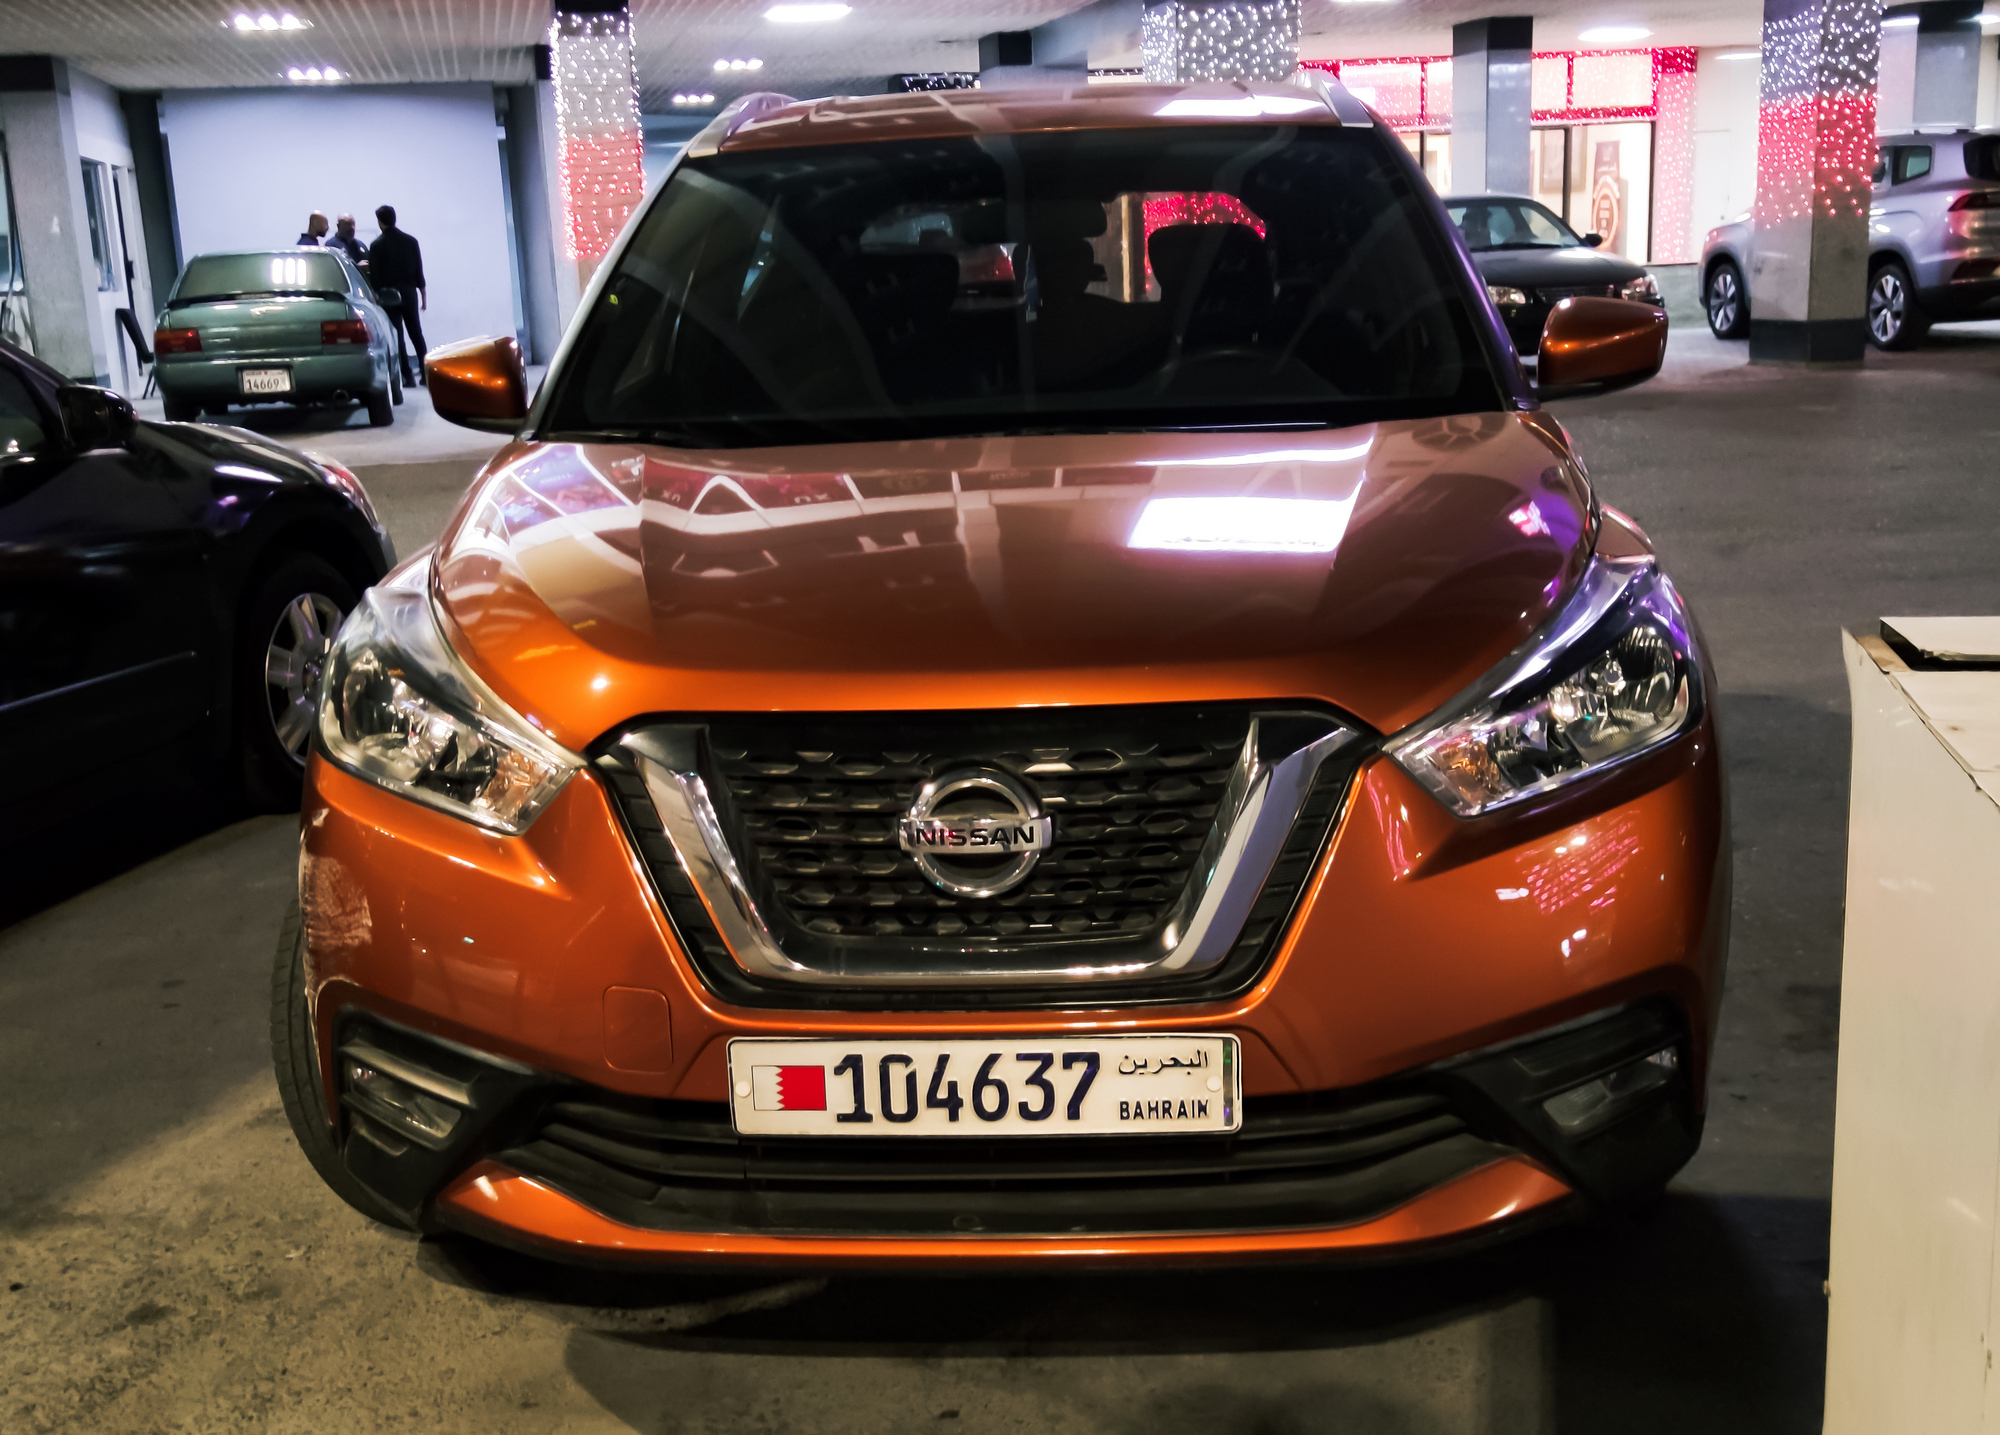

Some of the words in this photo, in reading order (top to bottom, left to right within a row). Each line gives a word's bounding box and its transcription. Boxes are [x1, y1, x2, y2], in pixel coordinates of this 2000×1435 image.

[916, 826, 1034, 846] NISSAN
[1118, 1049, 1209, 1075] البحرين
[833, 1052, 1101, 1122] 104637
[1119, 1099, 1209, 1120] BAHRAIN
